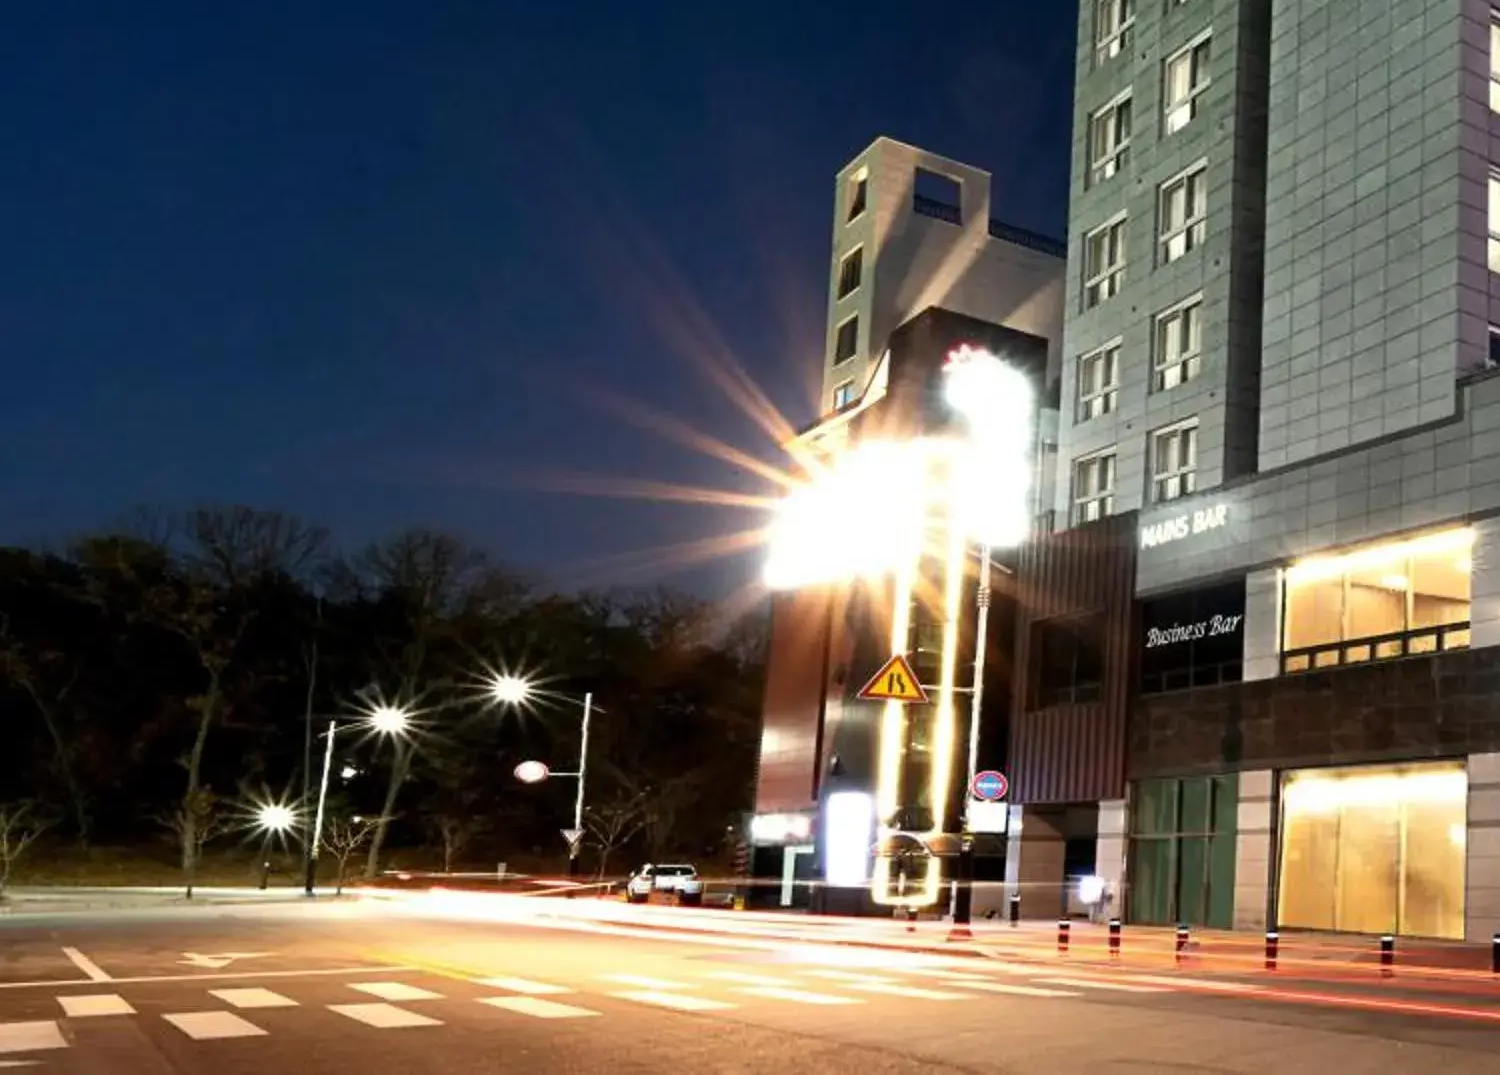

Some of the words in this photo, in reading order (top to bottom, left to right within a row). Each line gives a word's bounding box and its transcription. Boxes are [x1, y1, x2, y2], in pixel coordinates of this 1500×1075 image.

[1141, 515, 1189, 550] MAINS
[1192, 503, 1227, 534] BAR
[1145, 621, 1207, 648] Business
[1209, 613, 1242, 637] Bar
